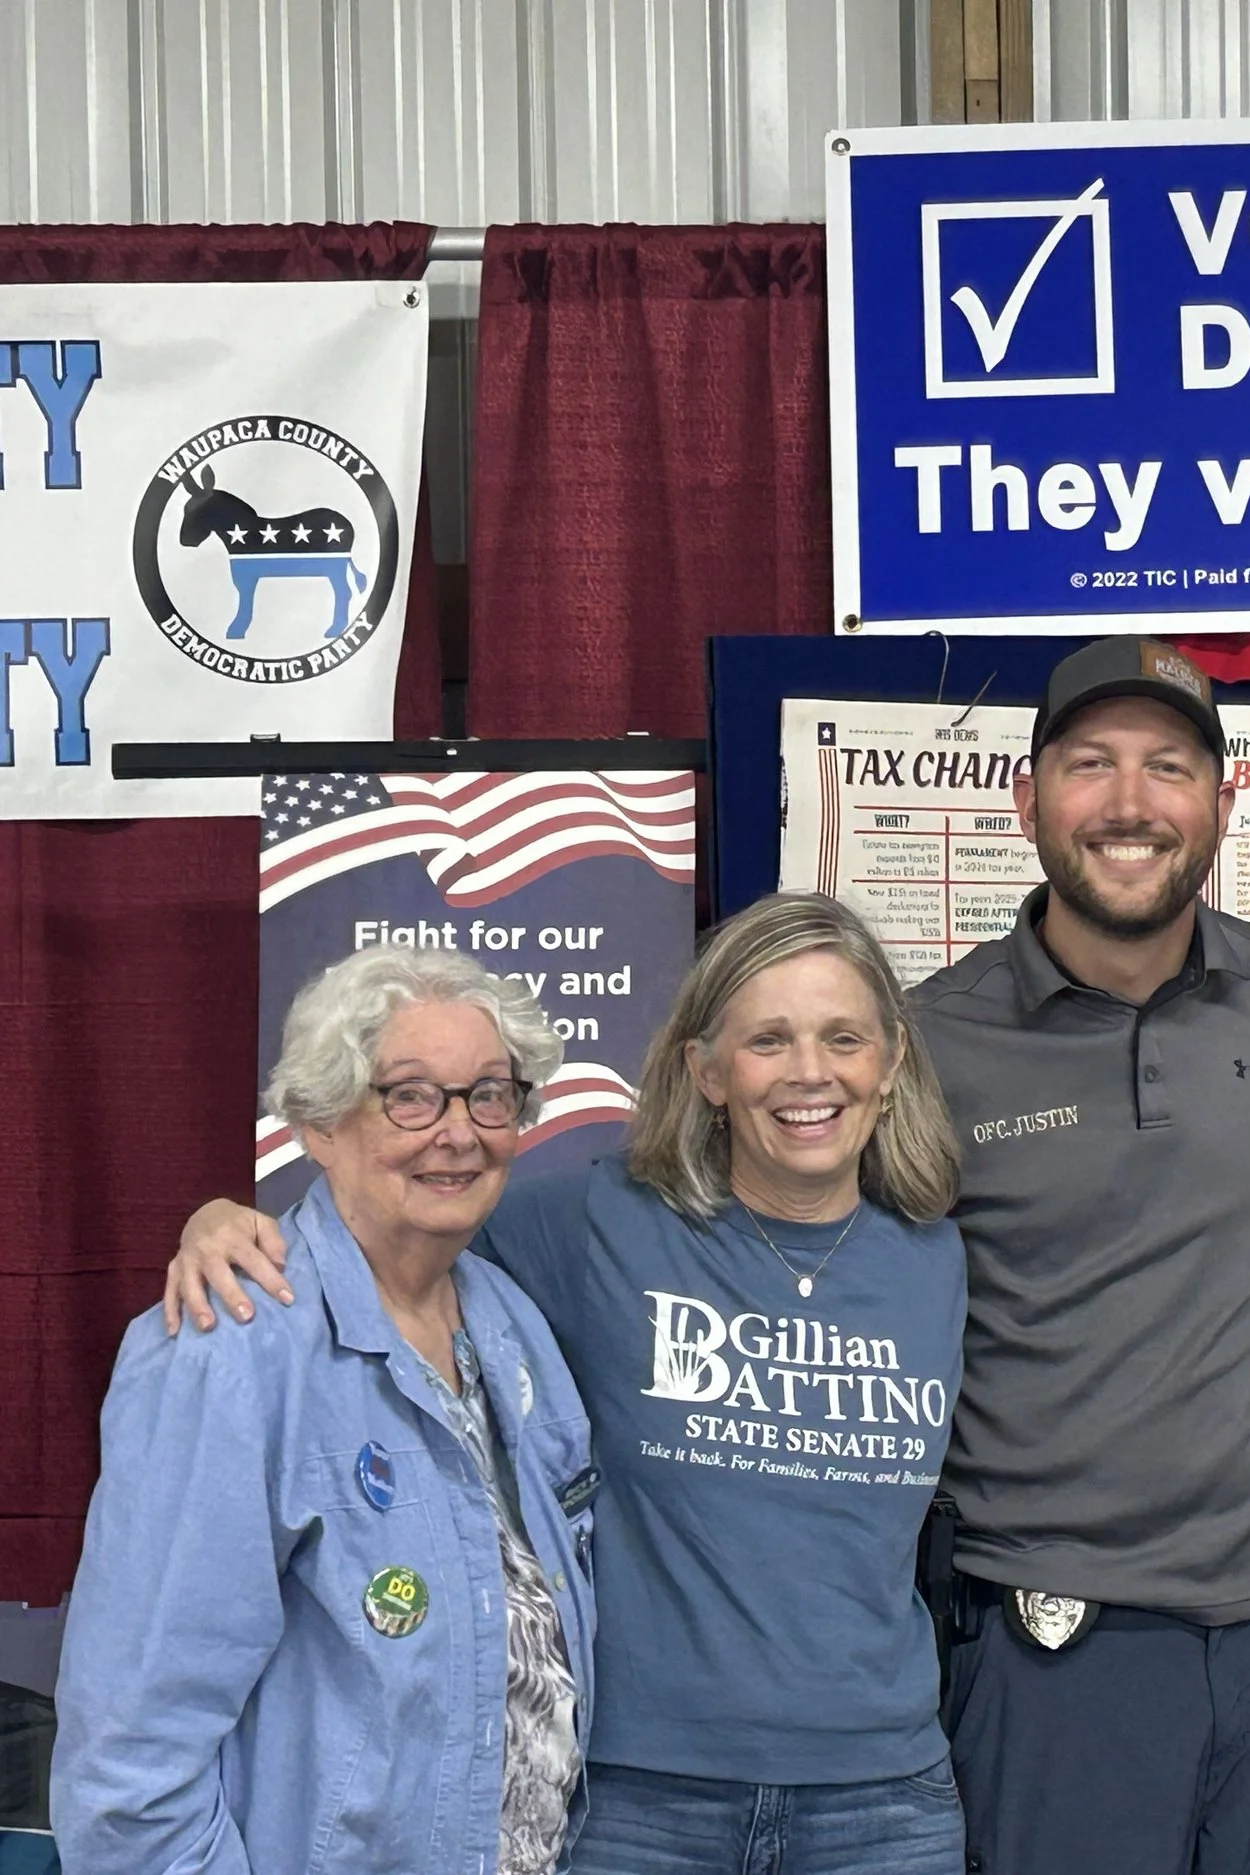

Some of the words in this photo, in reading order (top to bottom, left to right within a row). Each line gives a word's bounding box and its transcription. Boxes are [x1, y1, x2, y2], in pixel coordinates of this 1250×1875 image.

[157, 418, 272, 487] WAUPACA
[277, 418, 375, 482] COUNTY
[894, 444, 1163, 552] They
[1092, 570, 1139, 588] 2022
[1143, 569, 1177, 587] TIC
[1194, 567, 1238, 585] Paid
[161, 613, 304, 682] DEMOCRATIC
[306, 612, 374, 675] PARTY
[840, 748, 905, 787] TAX
[355, 920, 458, 949] Fight
[469, 920, 526, 950] for
[538, 926, 604, 950] our
[559, 965, 631, 995] and
[1013, 1105, 1079, 1137] JUSTIN
[640, 1289, 946, 1428] BATTINO
[728, 1312, 901, 1371] Gillian
[685, 1413, 779, 1450] STATE
[785, 1426, 898, 1460] SENATE
[902, 1437, 926, 1461] 29
[640, 1440, 671, 1460] Take
[731, 1454, 755, 1471] For
[758, 1457, 819, 1480] Families,
[387, 1577, 416, 1601] DO
